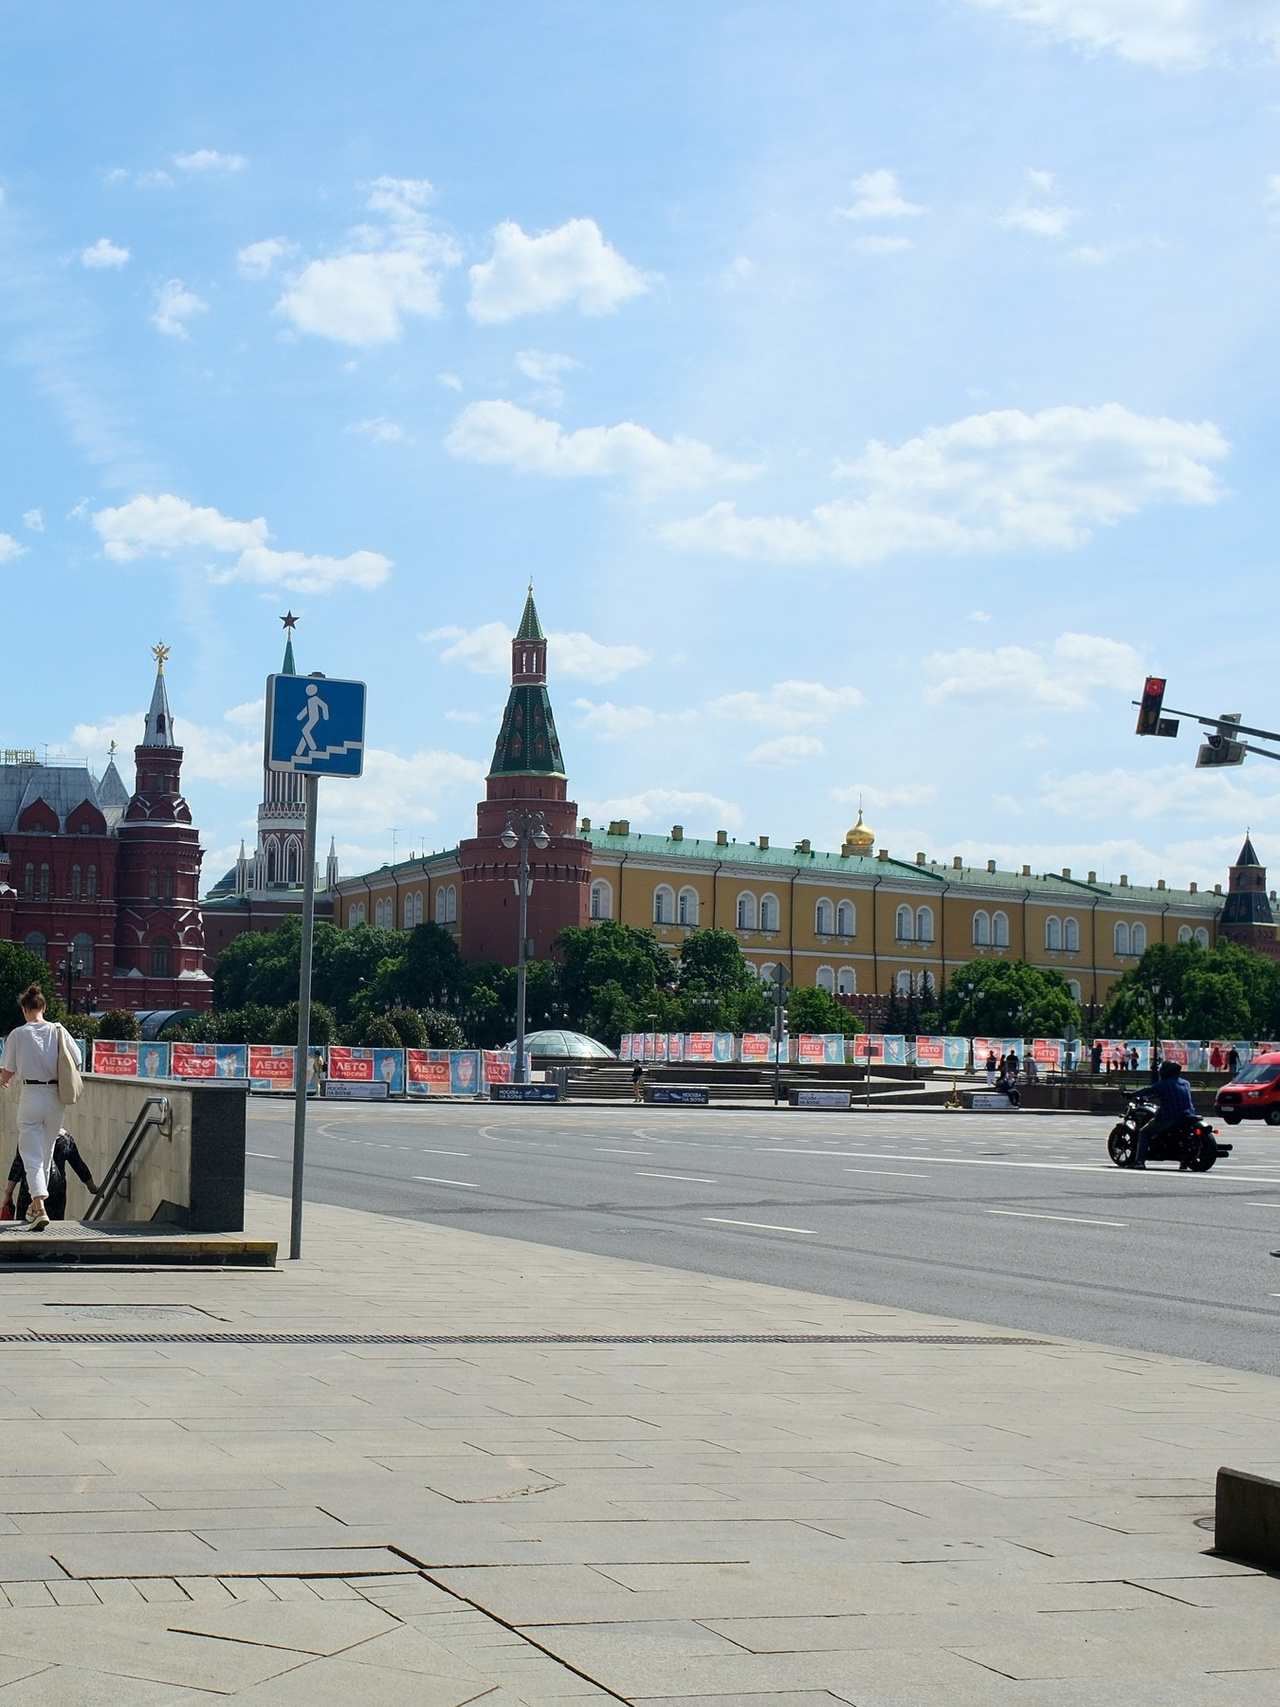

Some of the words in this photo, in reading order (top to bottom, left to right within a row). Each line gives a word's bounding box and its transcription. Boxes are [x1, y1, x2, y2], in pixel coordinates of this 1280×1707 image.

[100, 1056, 133, 1066] ЛЕТО
[179, 1058, 211, 1068] ЛЕТО
[256, 1060, 289, 1070] ЛЕТО
[336, 1062, 367, 1071] ЛЕТО
[414, 1064, 445, 1074] ЛЕТО
